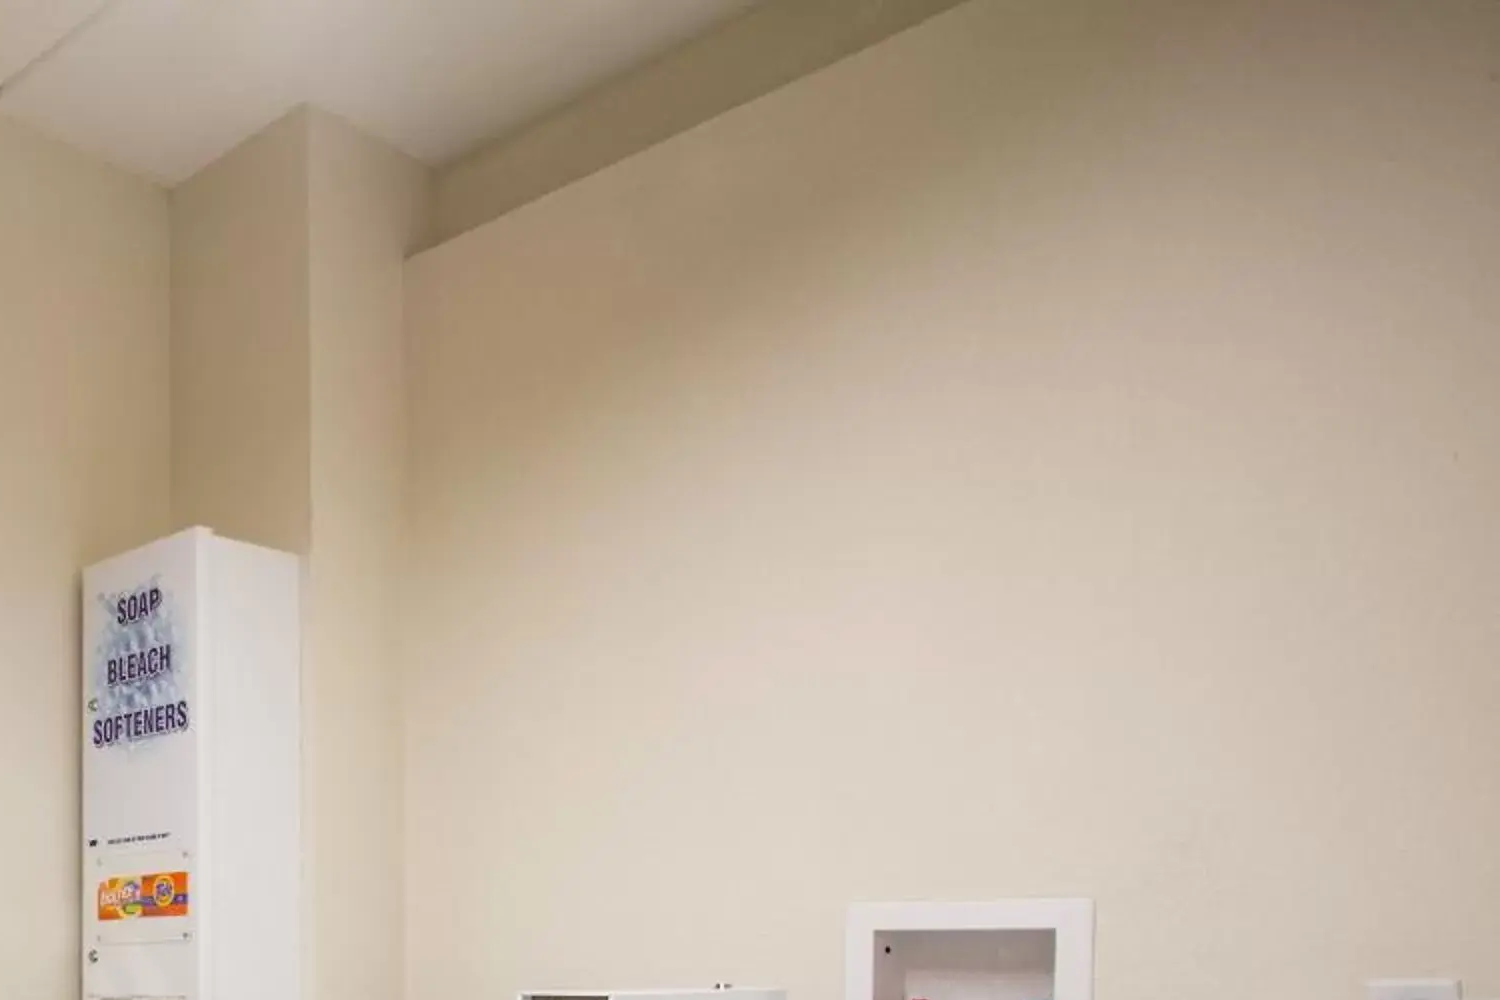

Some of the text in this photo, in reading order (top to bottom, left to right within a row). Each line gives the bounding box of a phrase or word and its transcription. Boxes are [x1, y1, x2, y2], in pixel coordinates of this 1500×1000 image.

[116, 587, 162, 626] SOAP
[106, 645, 172, 686] BLEACH
[93, 700, 189, 748] SOFTENERS
